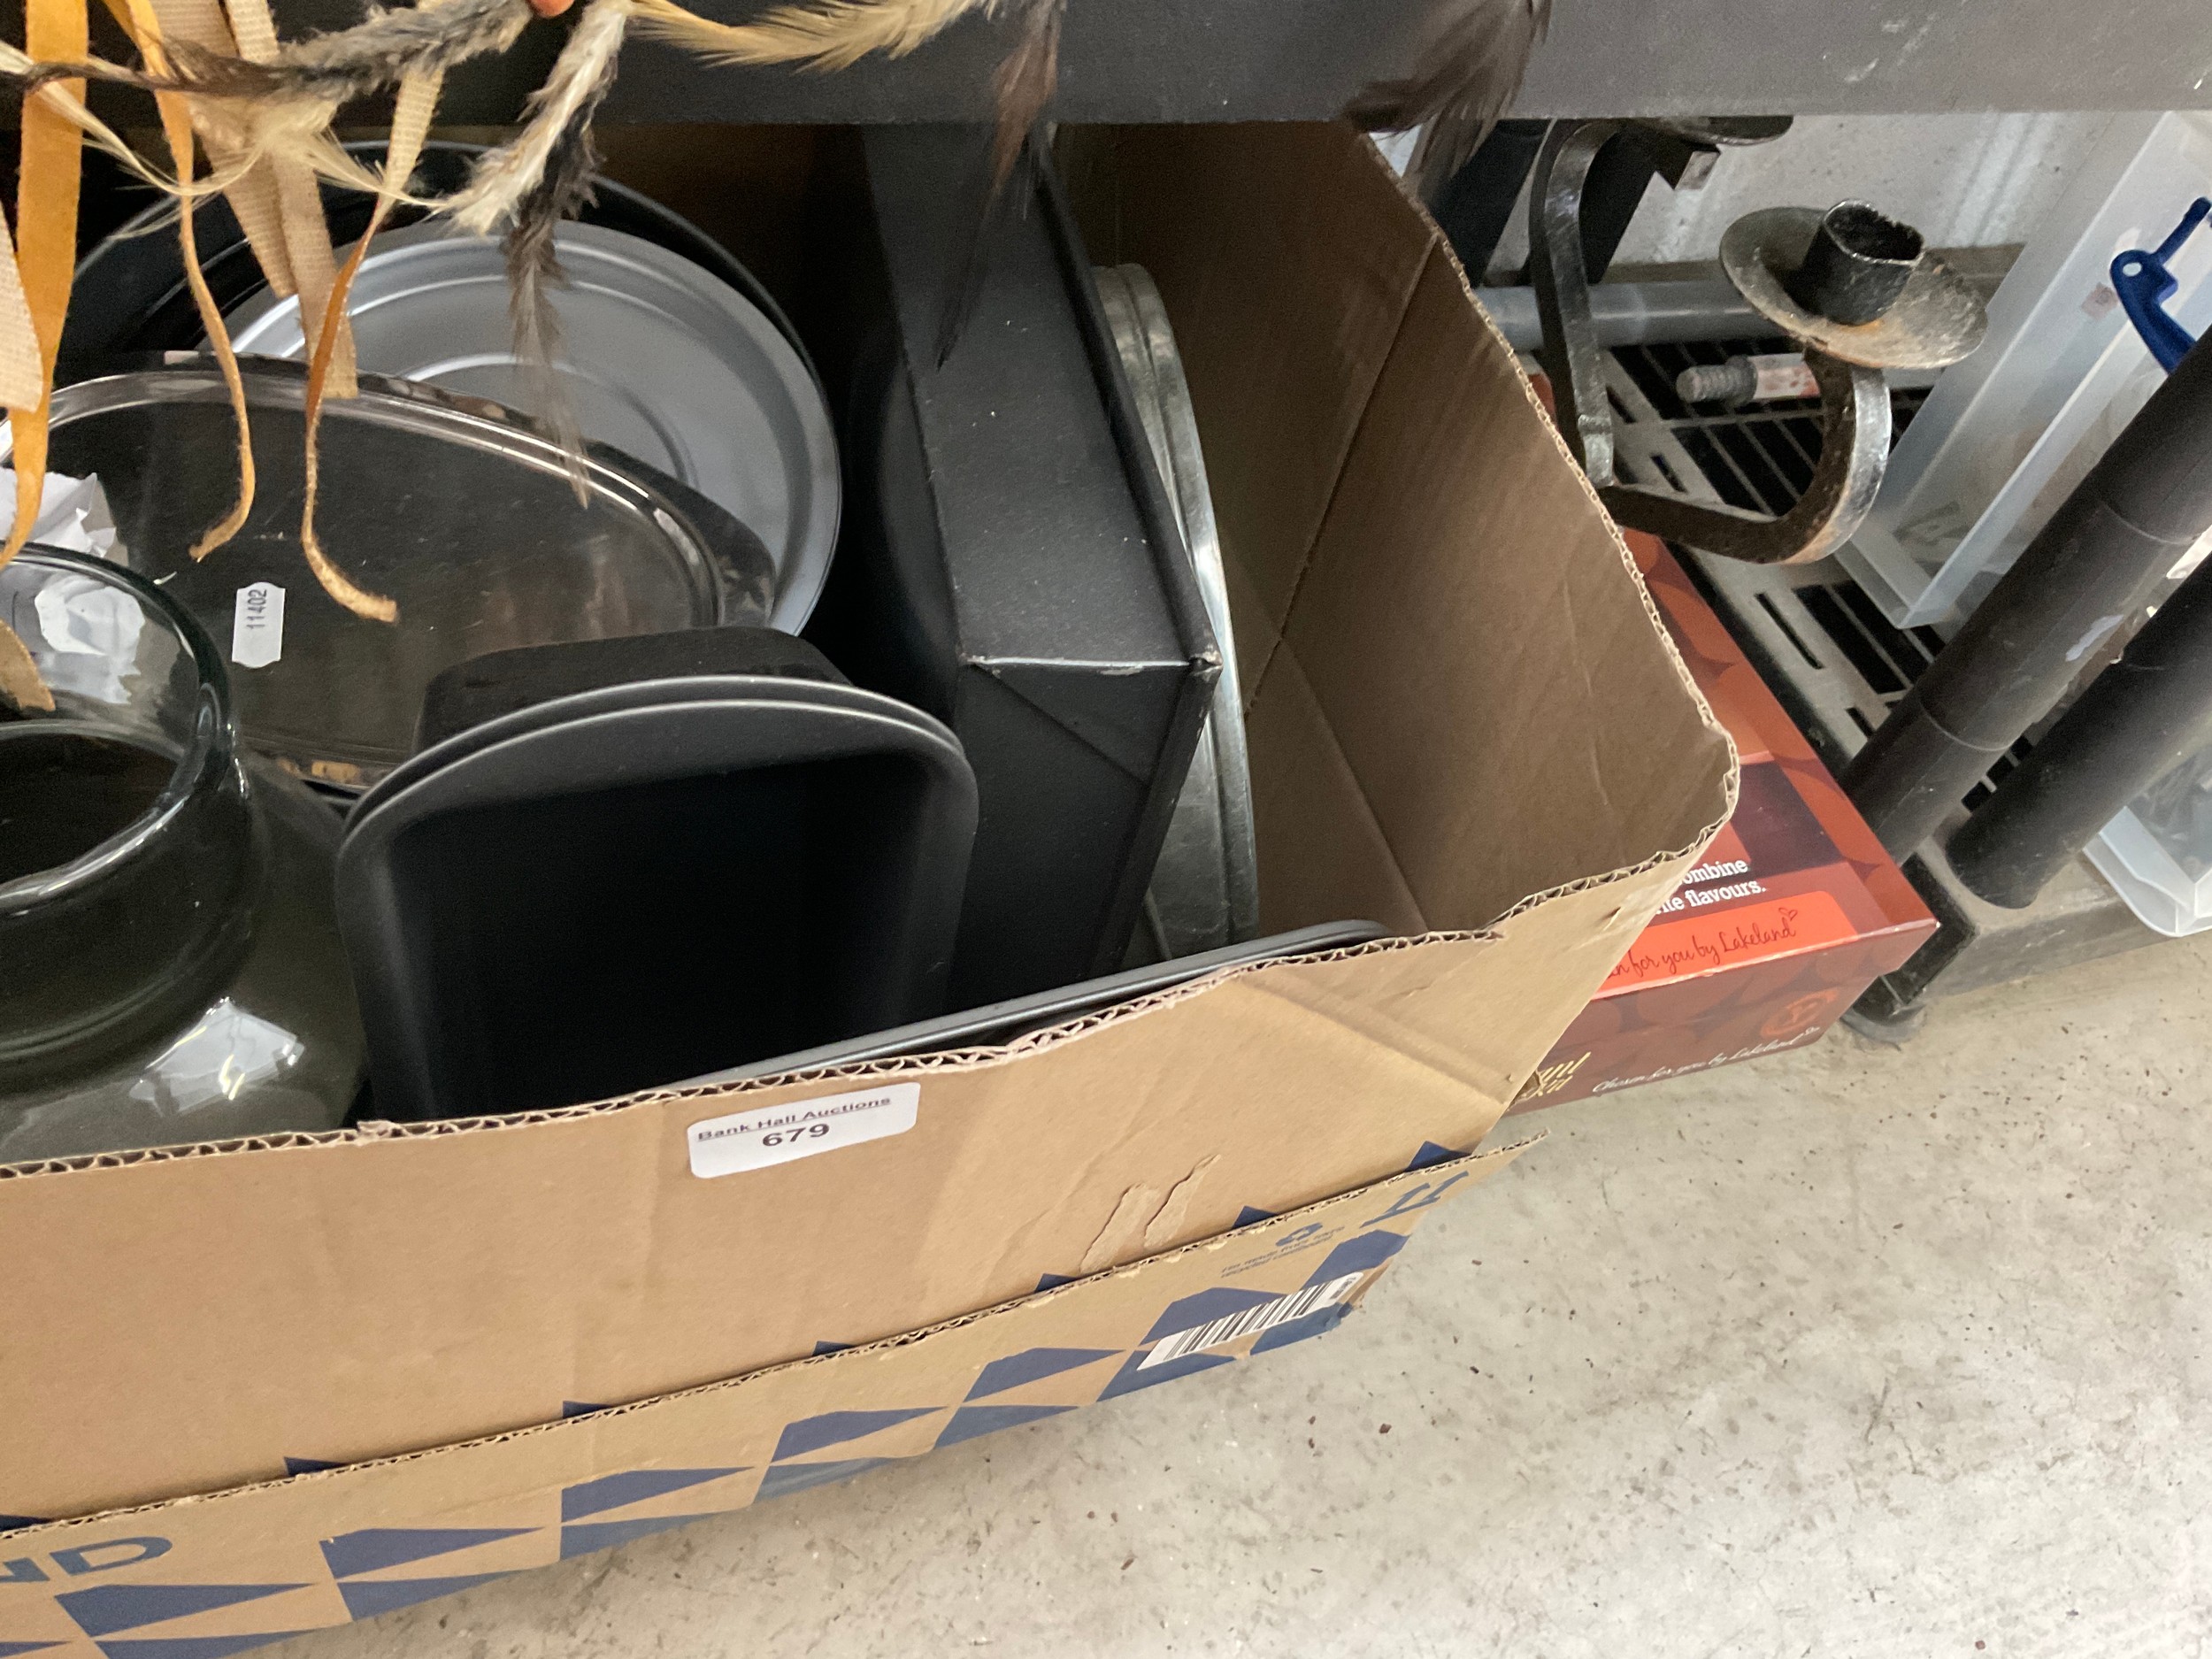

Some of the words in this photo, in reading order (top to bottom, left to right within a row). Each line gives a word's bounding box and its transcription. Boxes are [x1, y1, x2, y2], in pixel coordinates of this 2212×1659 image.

[246, 589, 267, 630] 11402
[1681, 859, 1748, 884] ombine
[1684, 880, 1766, 907] flavours.
[1662, 950, 1695, 975] you
[1692, 934, 1721, 965] by
[1718, 917, 1796, 953] Lakeland
[1729, 1032, 1805, 1060] Lakeland
[697, 1123, 750, 1141] Bank
[757, 1111, 796, 1129] Hall
[803, 1096, 891, 1121] Auctions
[762, 1123, 830, 1147] 679
